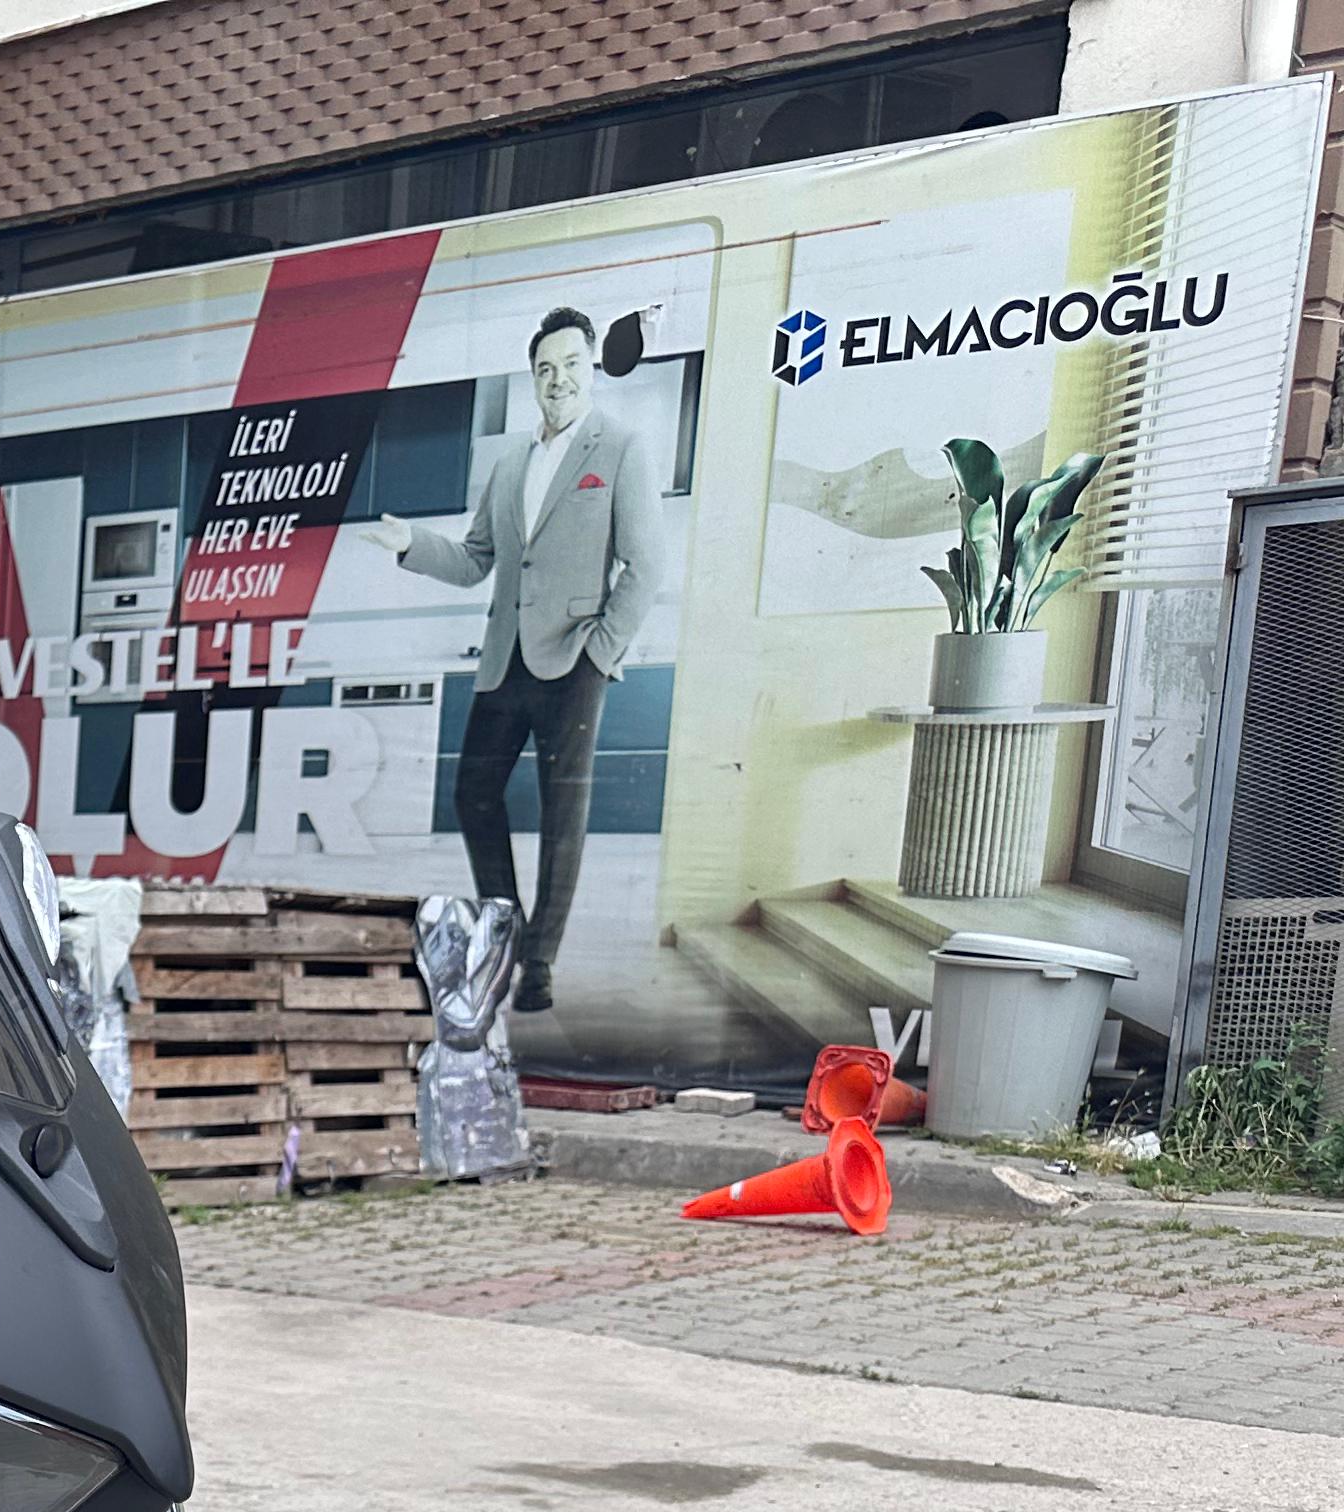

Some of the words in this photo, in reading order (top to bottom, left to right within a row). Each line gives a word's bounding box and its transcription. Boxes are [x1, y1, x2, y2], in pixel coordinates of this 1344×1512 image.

[839, 271, 1229, 367] ELMACIOĞLU
[228, 408, 298, 457] İLERİ
[215, 451, 350, 506] TEKNOLOJİ
[198, 517, 250, 555] HER
[250, 512, 301, 551] EVE
[184, 562, 285, 606] ULAŞSIN
